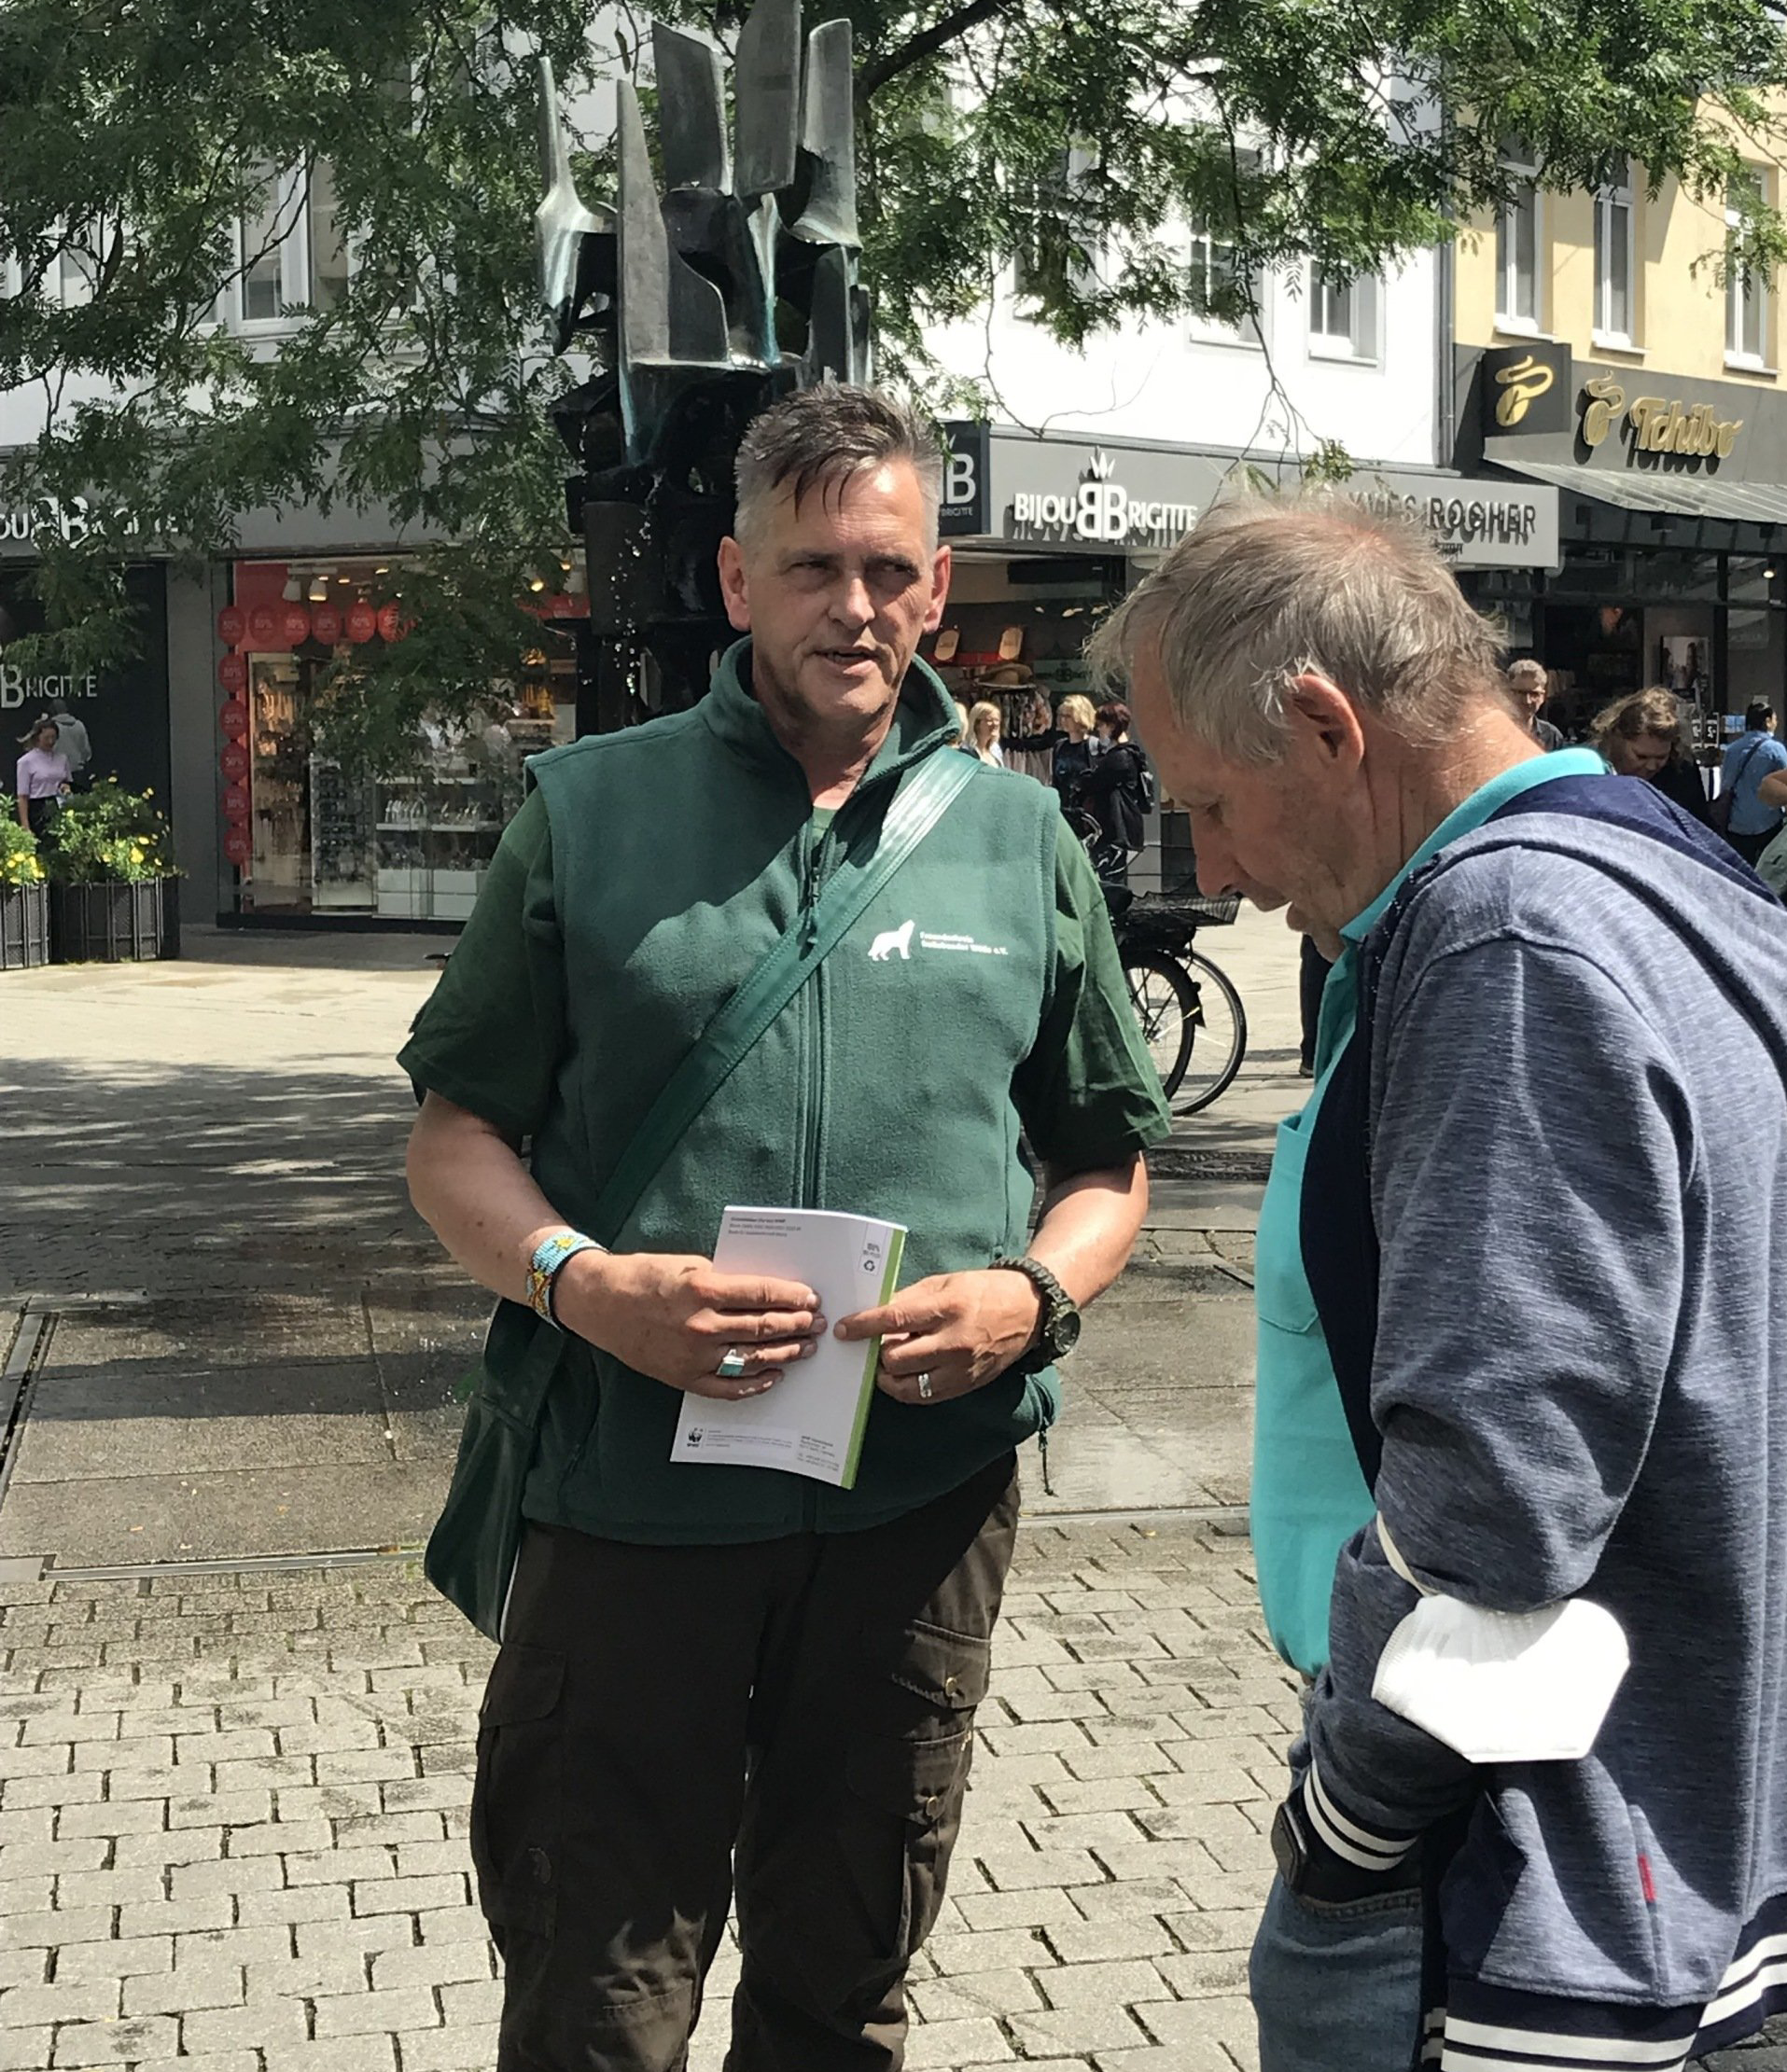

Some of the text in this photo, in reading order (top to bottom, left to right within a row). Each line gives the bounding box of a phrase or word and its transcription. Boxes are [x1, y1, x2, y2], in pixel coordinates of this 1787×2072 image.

[1629, 396, 1743, 458] Tchibo
[1013, 493, 1076, 524] BIJOU
[1426, 495, 1536, 534] ROCHER
